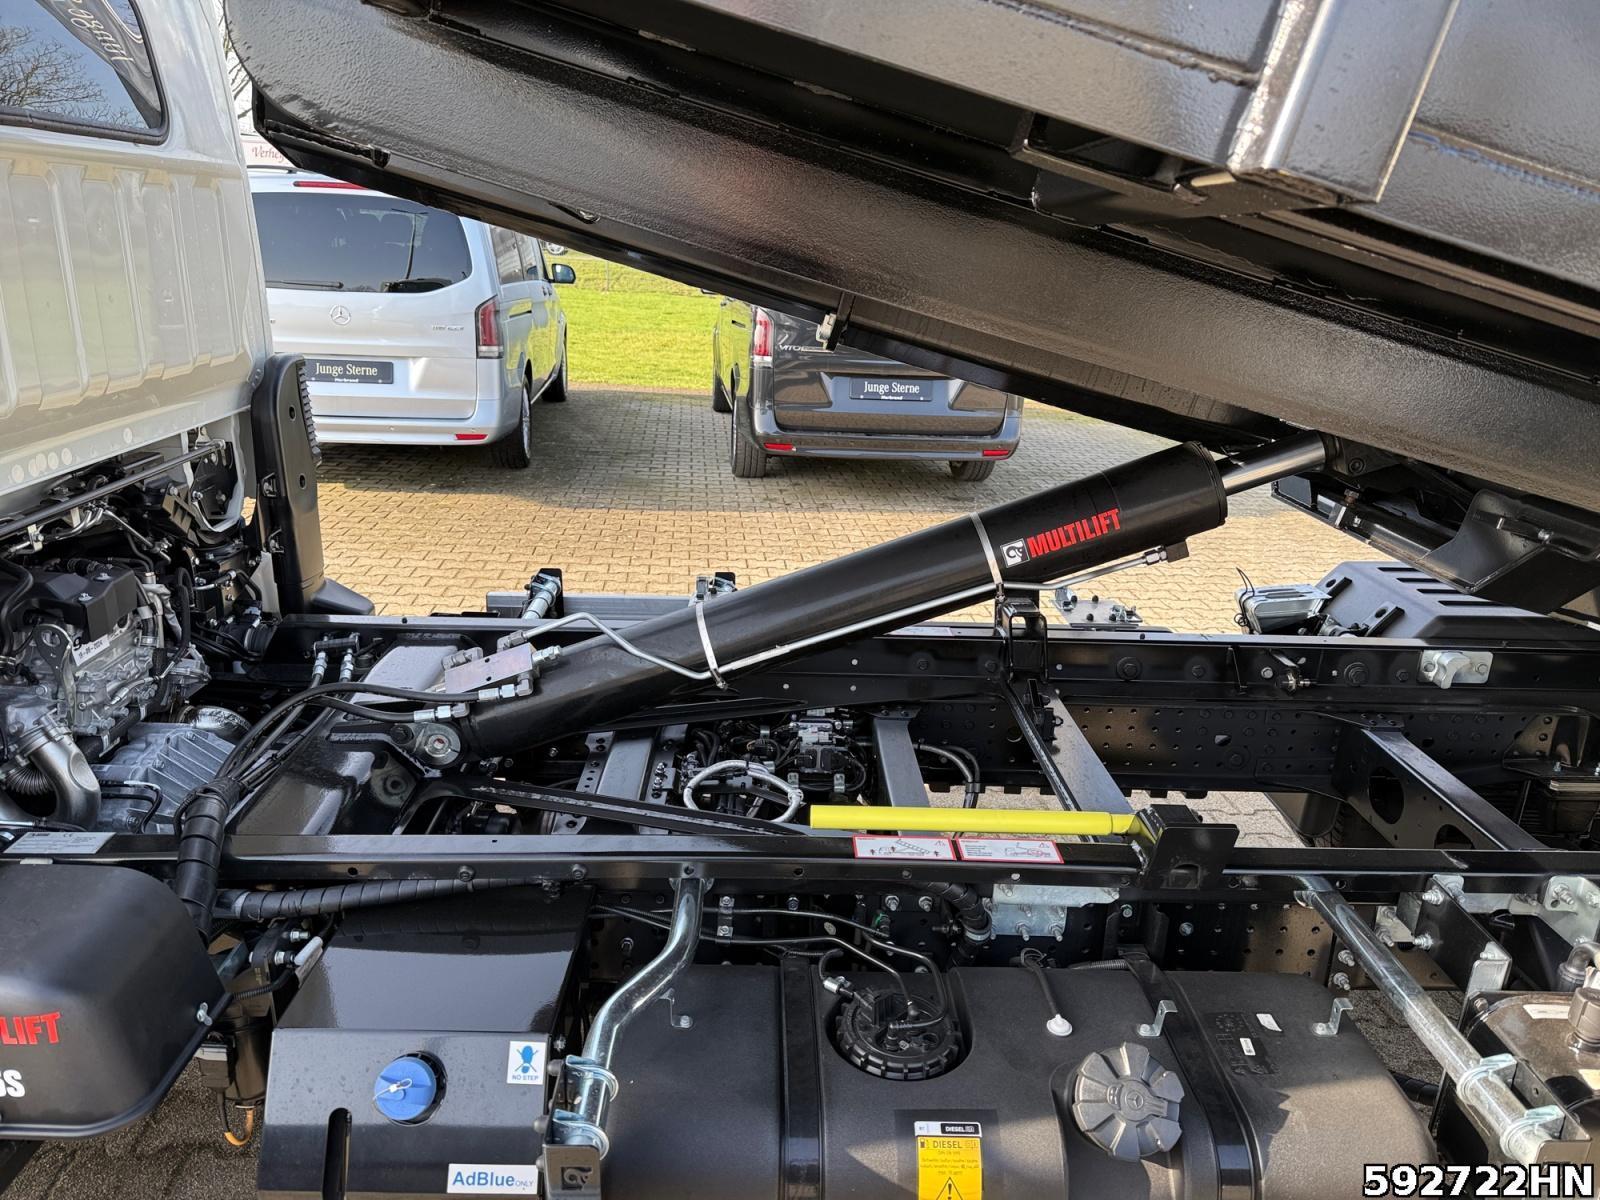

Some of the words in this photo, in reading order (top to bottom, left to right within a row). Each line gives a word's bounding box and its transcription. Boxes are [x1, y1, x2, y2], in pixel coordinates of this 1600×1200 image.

[315, 362, 344, 377] Junge
[346, 363, 378, 376] Sterne
[863, 381, 890, 395] Junge
[891, 382, 920, 394] Sterne
[1026, 508, 1120, 558] MULTILIFT
[932, 1140, 963, 1149] DIESEL
[452, 1170, 515, 1187] AdBlue
